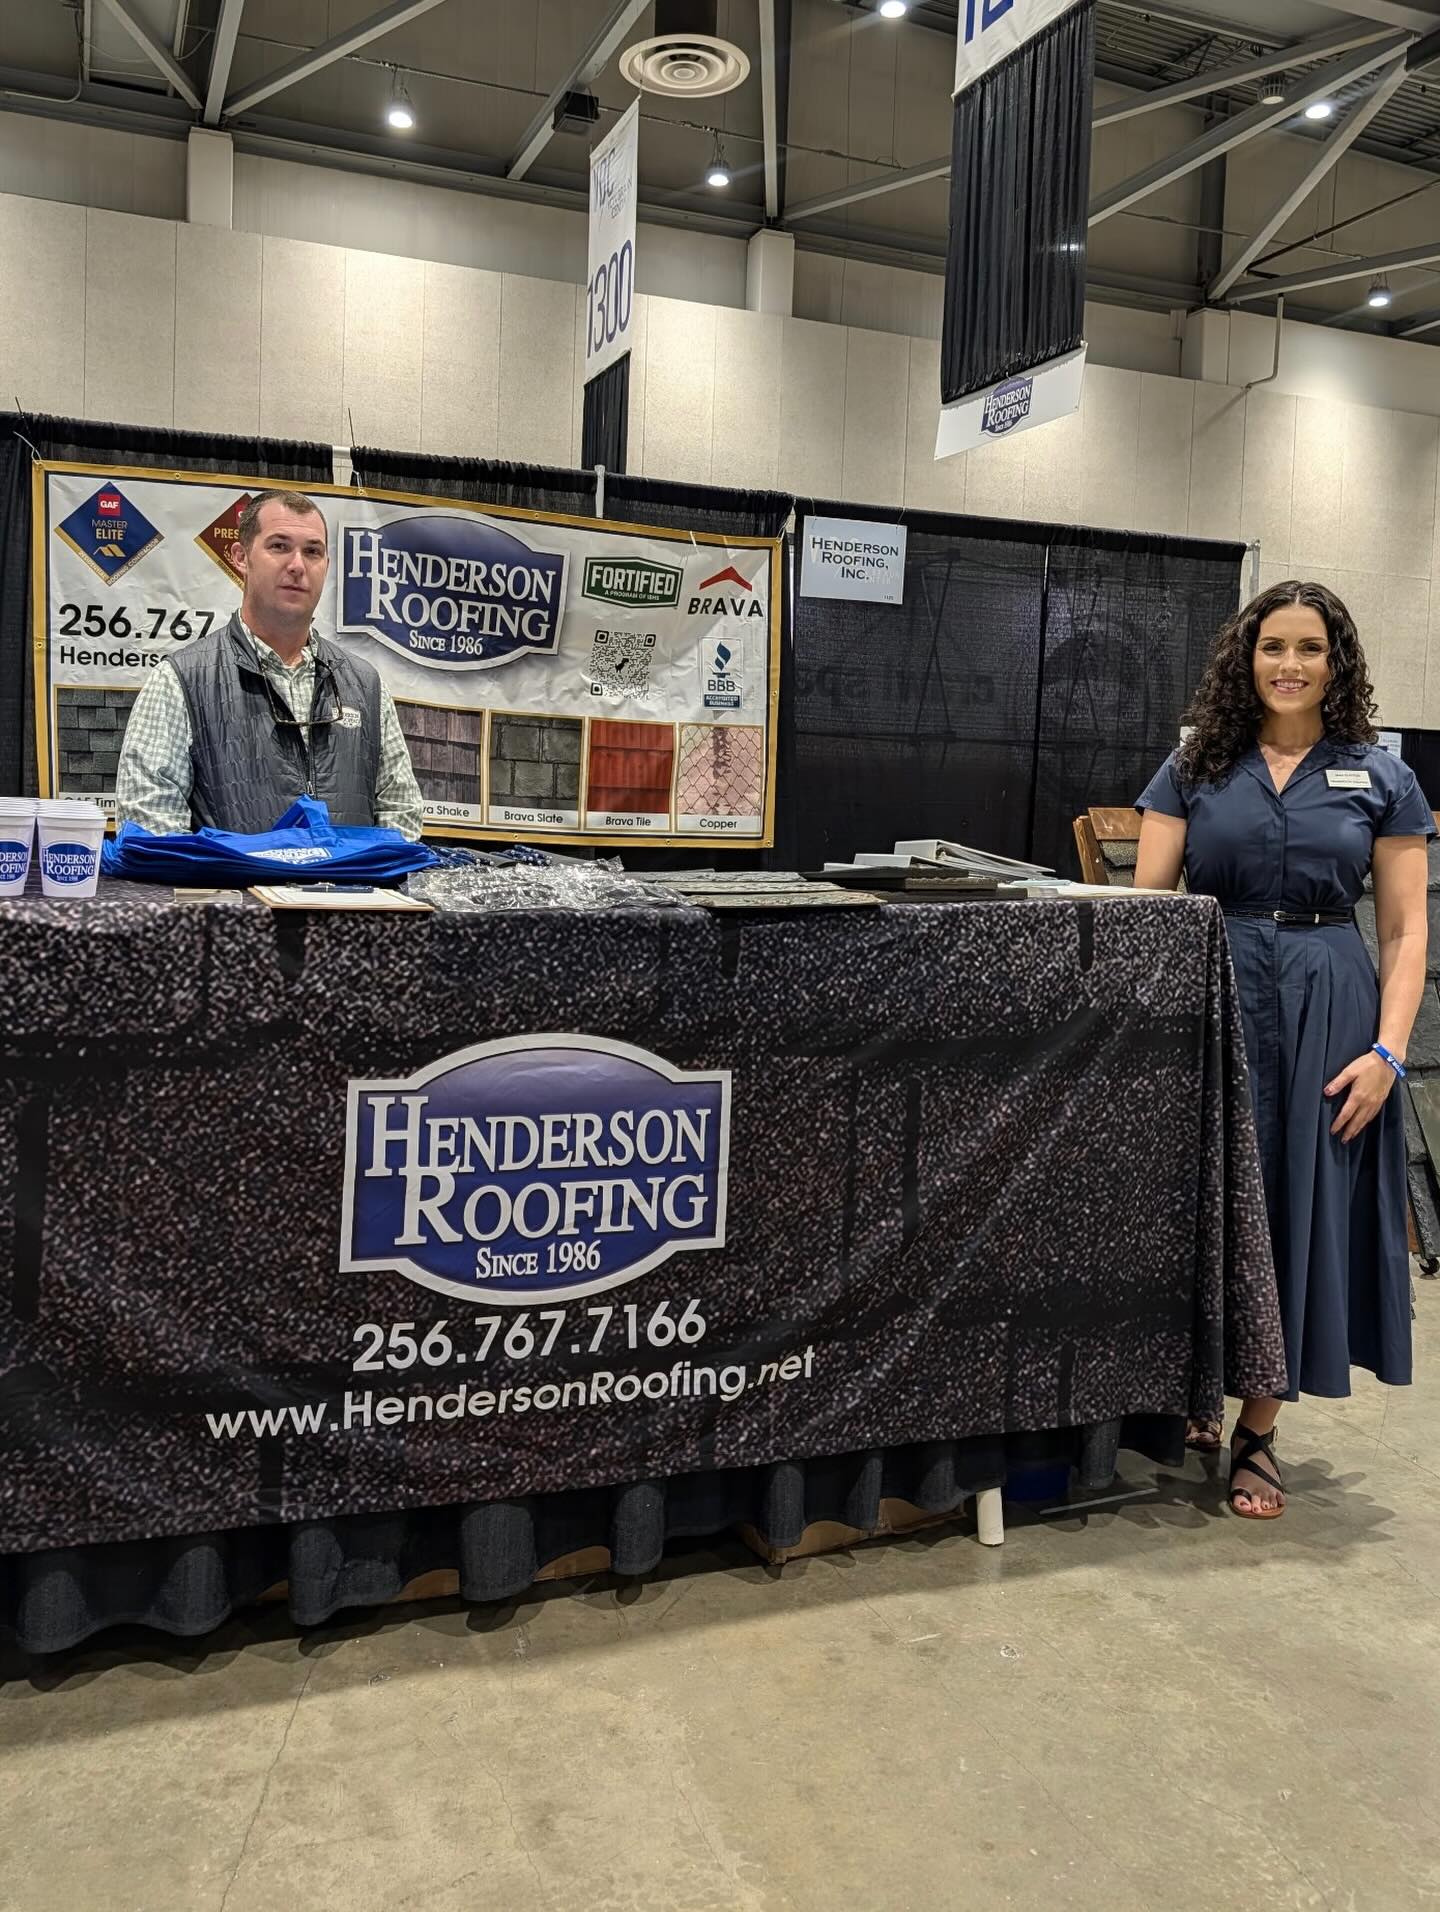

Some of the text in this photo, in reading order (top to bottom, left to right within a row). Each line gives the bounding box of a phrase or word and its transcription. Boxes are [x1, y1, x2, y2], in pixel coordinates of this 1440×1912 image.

[587, 239, 632, 358] 1300
[985, 384, 1031, 414] HENDERSON
[986, 401, 1029, 428] ROOFING
[100, 500, 119, 509] GAF
[91, 519, 128, 529] MASTER
[96, 530, 125, 540] ELITE
[812, 537, 899, 556] HENDERSON
[349, 531, 556, 604] HENDERSON
[821, 551, 889, 570] ROOFING,
[591, 565, 675, 596] FORTIFIED
[841, 566, 870, 580] INC.
[366, 574, 550, 641] ROOFING
[687, 597, 764, 618] BRAVA
[409, 630, 484, 656] SINCE 1986
[708, 680, 735, 692] BBB
[436, 805, 470, 817] Shake
[504, 810, 564, 823] Brava Slate
[605, 816, 651, 827] Brava Tile
[699, 818, 738, 830] Copper
[43, 849, 96, 864] HENDERSON
[46, 860, 94, 876] ROOFING
[364, 1095, 711, 1178] HENDERSON
[394, 1168, 709, 1246] ROOFING
[476, 1240, 600, 1280] SINCE 1986
[352, 1299, 707, 1372] 256.767.7166
[205, 1344, 816, 1440] www.HendersonRoofing.net
